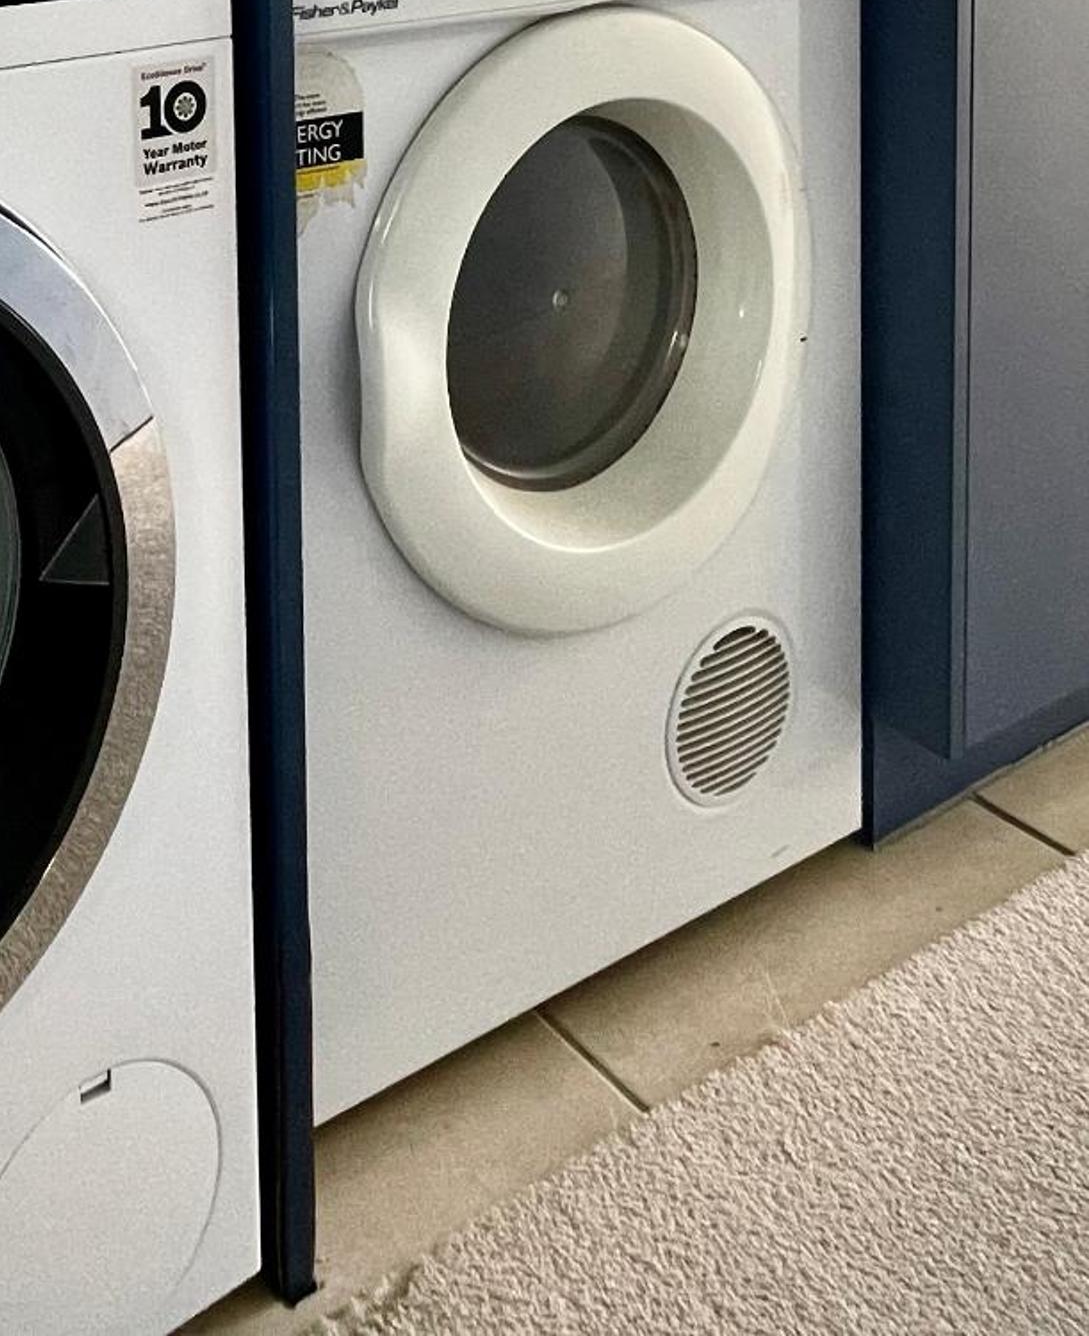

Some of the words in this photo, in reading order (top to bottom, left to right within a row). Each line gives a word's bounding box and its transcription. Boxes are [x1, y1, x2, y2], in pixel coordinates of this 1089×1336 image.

[139, 79, 207, 140] 10
[297, 119, 344, 144] ERGY
[142, 145, 170, 160] Year
[172, 140, 208, 156] Motor
[296, 143, 342, 166] TING
[143, 153, 208, 176] Warranty
